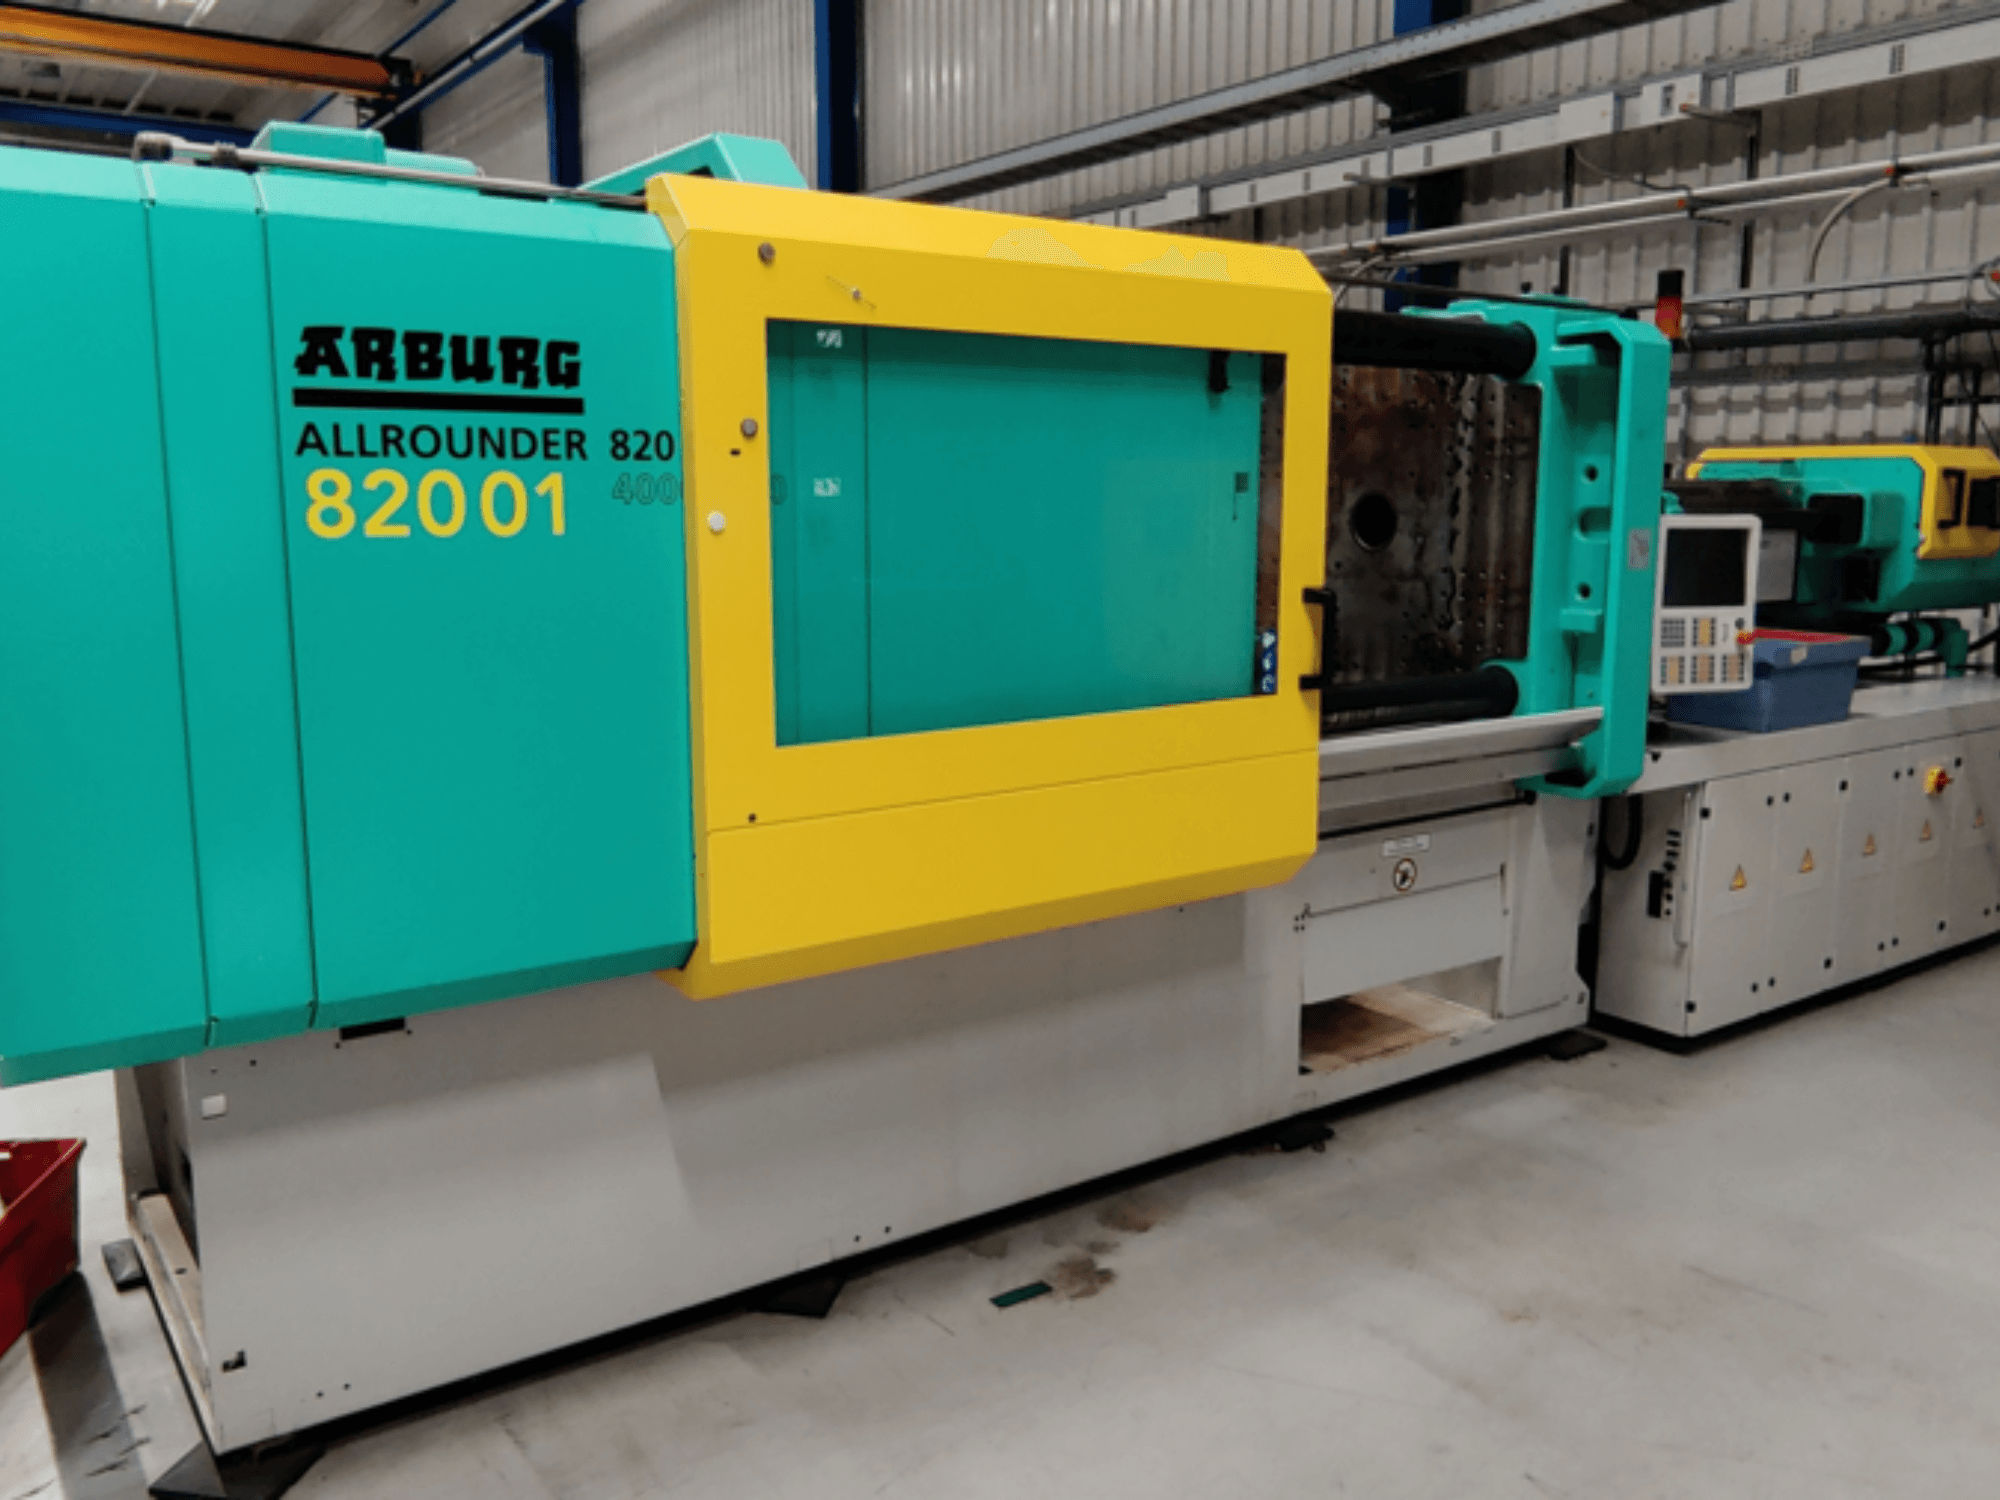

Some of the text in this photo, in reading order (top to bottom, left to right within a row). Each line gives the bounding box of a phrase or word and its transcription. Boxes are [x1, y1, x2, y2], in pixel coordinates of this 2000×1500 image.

[294, 326, 581, 389] ARBURG
[295, 422, 675, 462] ALLROUNDER 820
